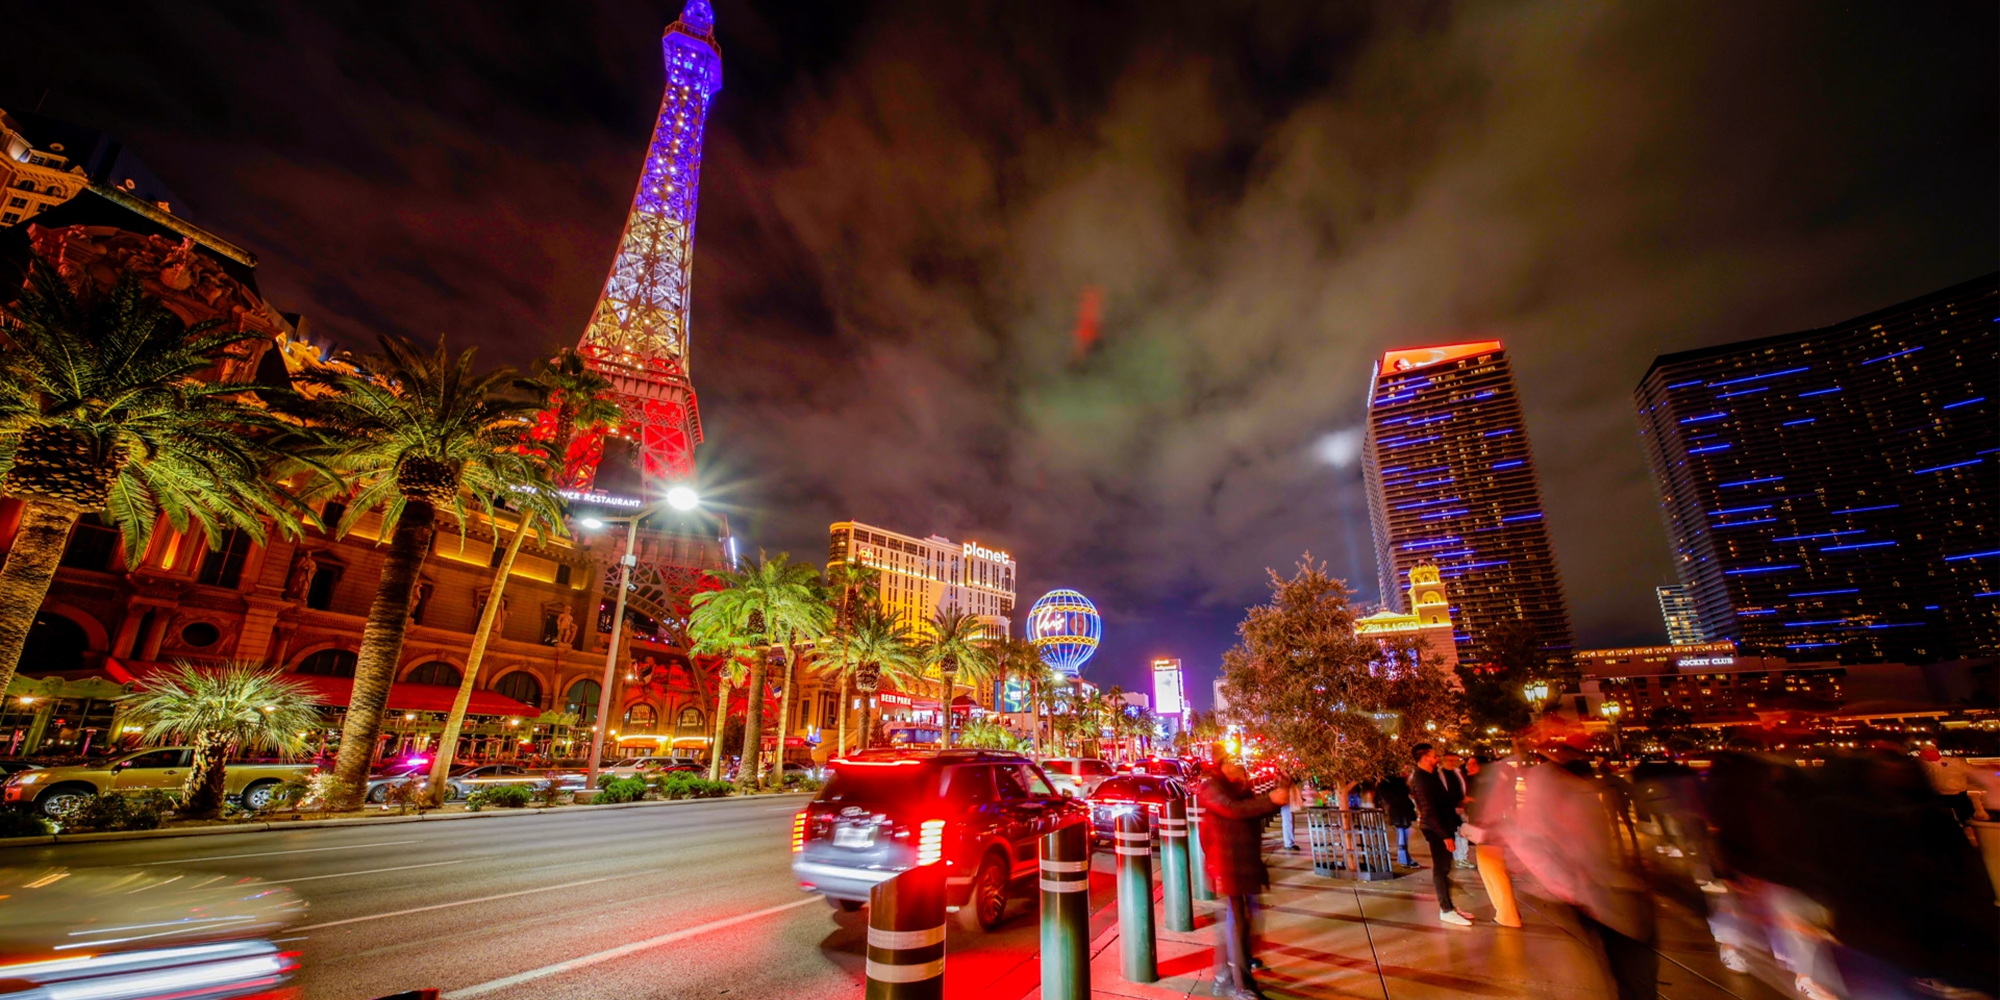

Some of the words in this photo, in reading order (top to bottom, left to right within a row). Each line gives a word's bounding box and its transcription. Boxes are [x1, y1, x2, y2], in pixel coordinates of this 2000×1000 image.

[584, 493, 641, 507] RESTAURANT
[962, 541, 1009, 565] planet
[1679, 658, 1709, 666] JOCKEY
[881, 693, 896, 703] BEER
[897, 696, 911, 705] PARK
